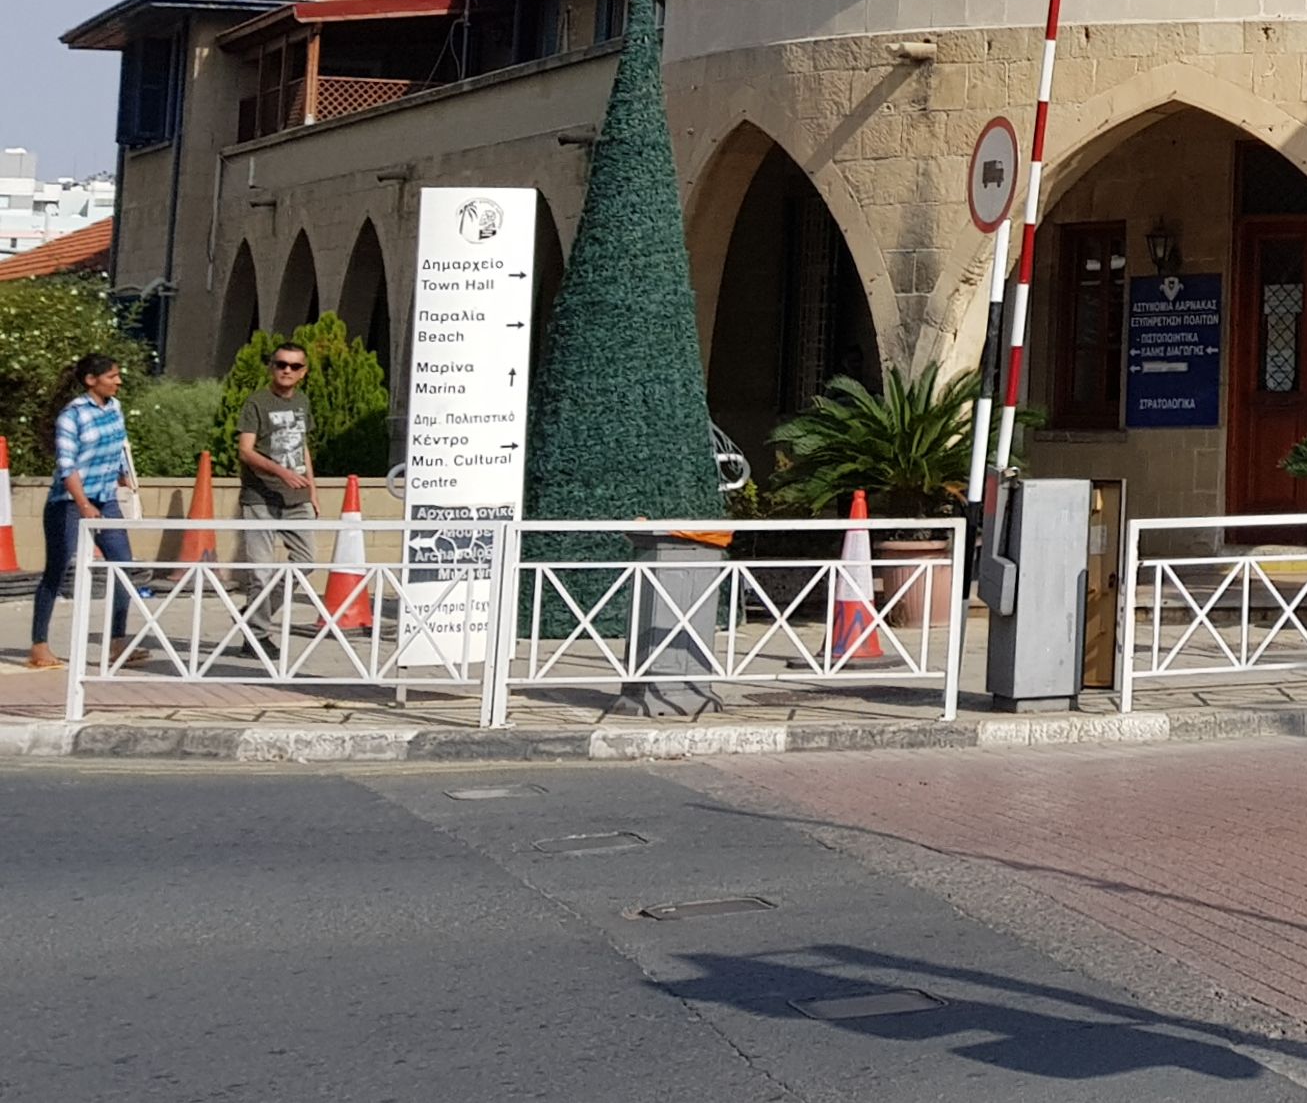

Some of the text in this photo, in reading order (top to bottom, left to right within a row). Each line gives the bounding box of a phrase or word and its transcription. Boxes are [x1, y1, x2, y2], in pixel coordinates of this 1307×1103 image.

[422, 258, 504, 272] Δημαρχείο
[421, 279, 494, 291] Town Hall
[419, 310, 485, 324] Παραλία
[418, 331, 464, 342] Beach
[416, 361, 475, 375] Μαρίνα
[415, 383, 466, 394] Marina
[412, 434, 469, 447] Κέντρο
[411, 453, 512, 467] Mun. Cultural
[411, 477, 458, 489] Centre
[425, 621, 489, 633] Worksops
